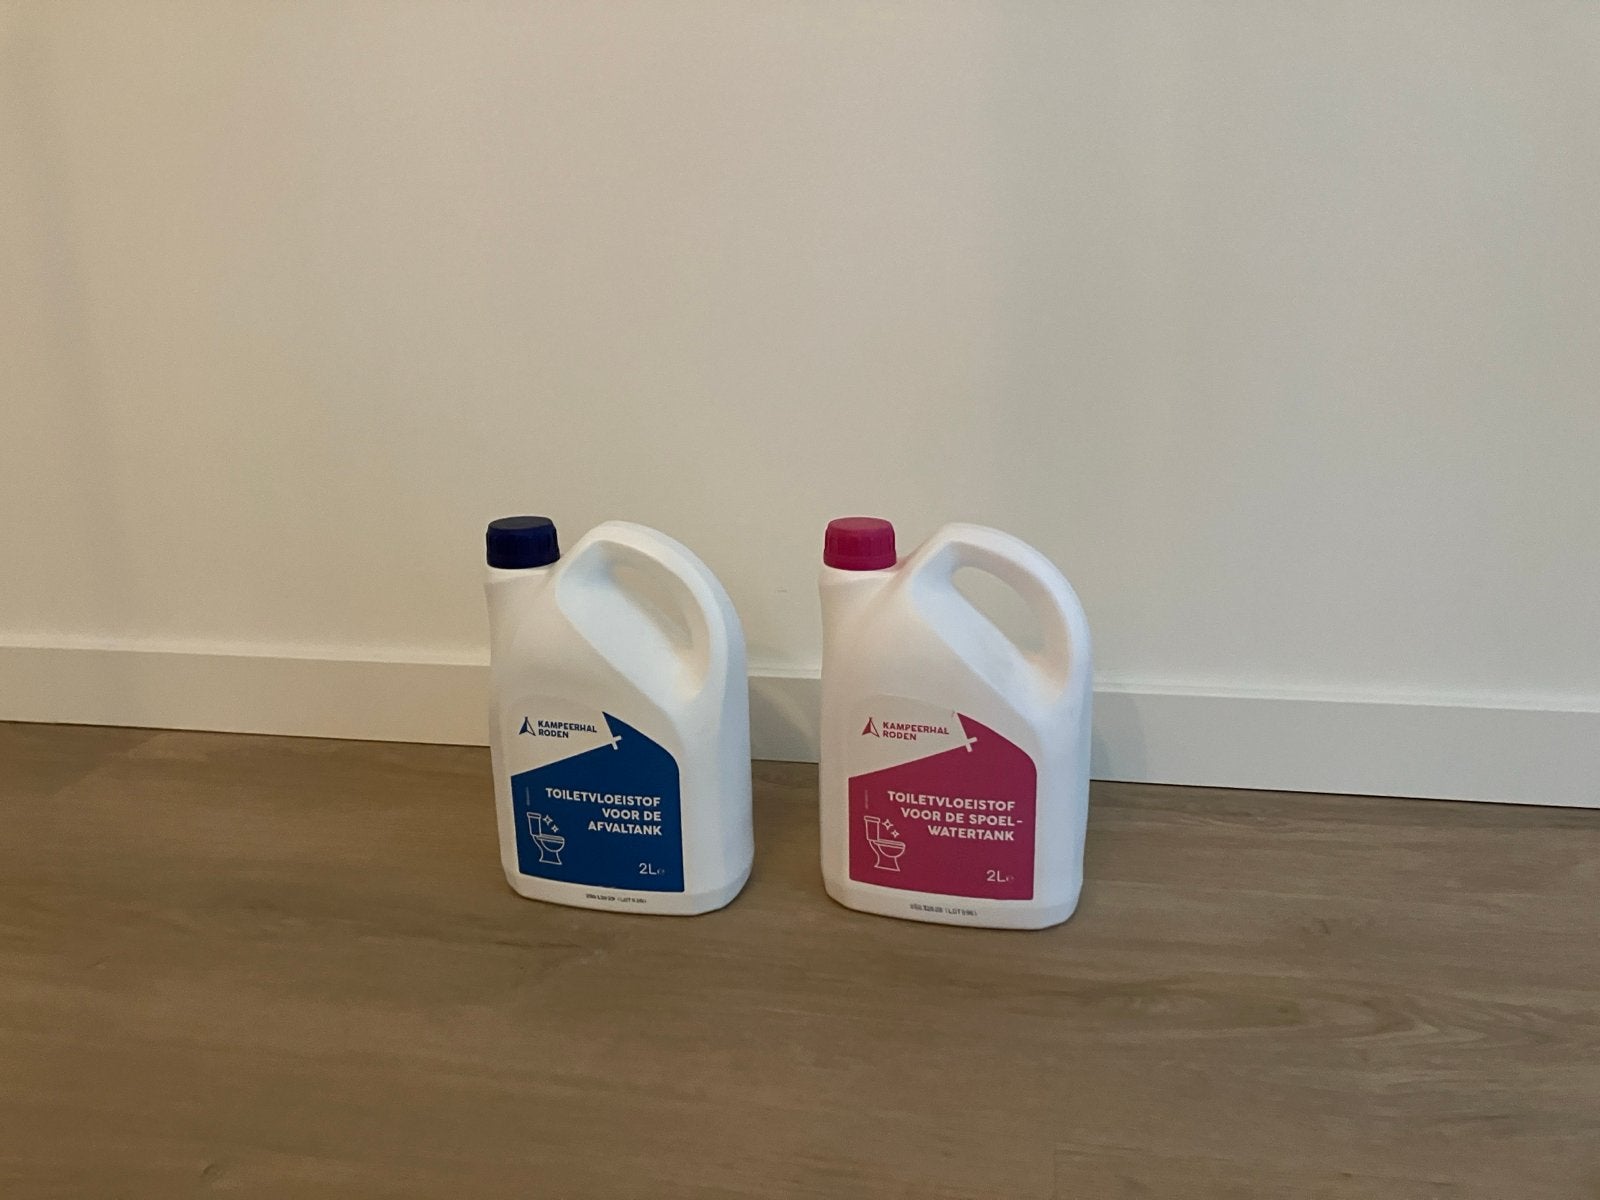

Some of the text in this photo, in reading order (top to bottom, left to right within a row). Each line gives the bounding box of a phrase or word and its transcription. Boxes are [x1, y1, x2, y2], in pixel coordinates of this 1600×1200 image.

[537, 720, 598, 734] KAMPEERHAL
[538, 729, 570, 739] RODEN
[882, 721, 950, 736] KAMPEERHAL
[882, 730, 918, 741] RODEN
[545, 787, 661, 808] TOILETVLOEISTOF
[887, 790, 1016, 812] TOILETVLOEISTOF
[602, 808, 662, 822] VOOR DE
[900, 807, 1023, 827] VOOR DE SPOEL-
[587, 820, 663, 836] AFVALTANK
[927, 825, 1014, 841] WATERTANK
